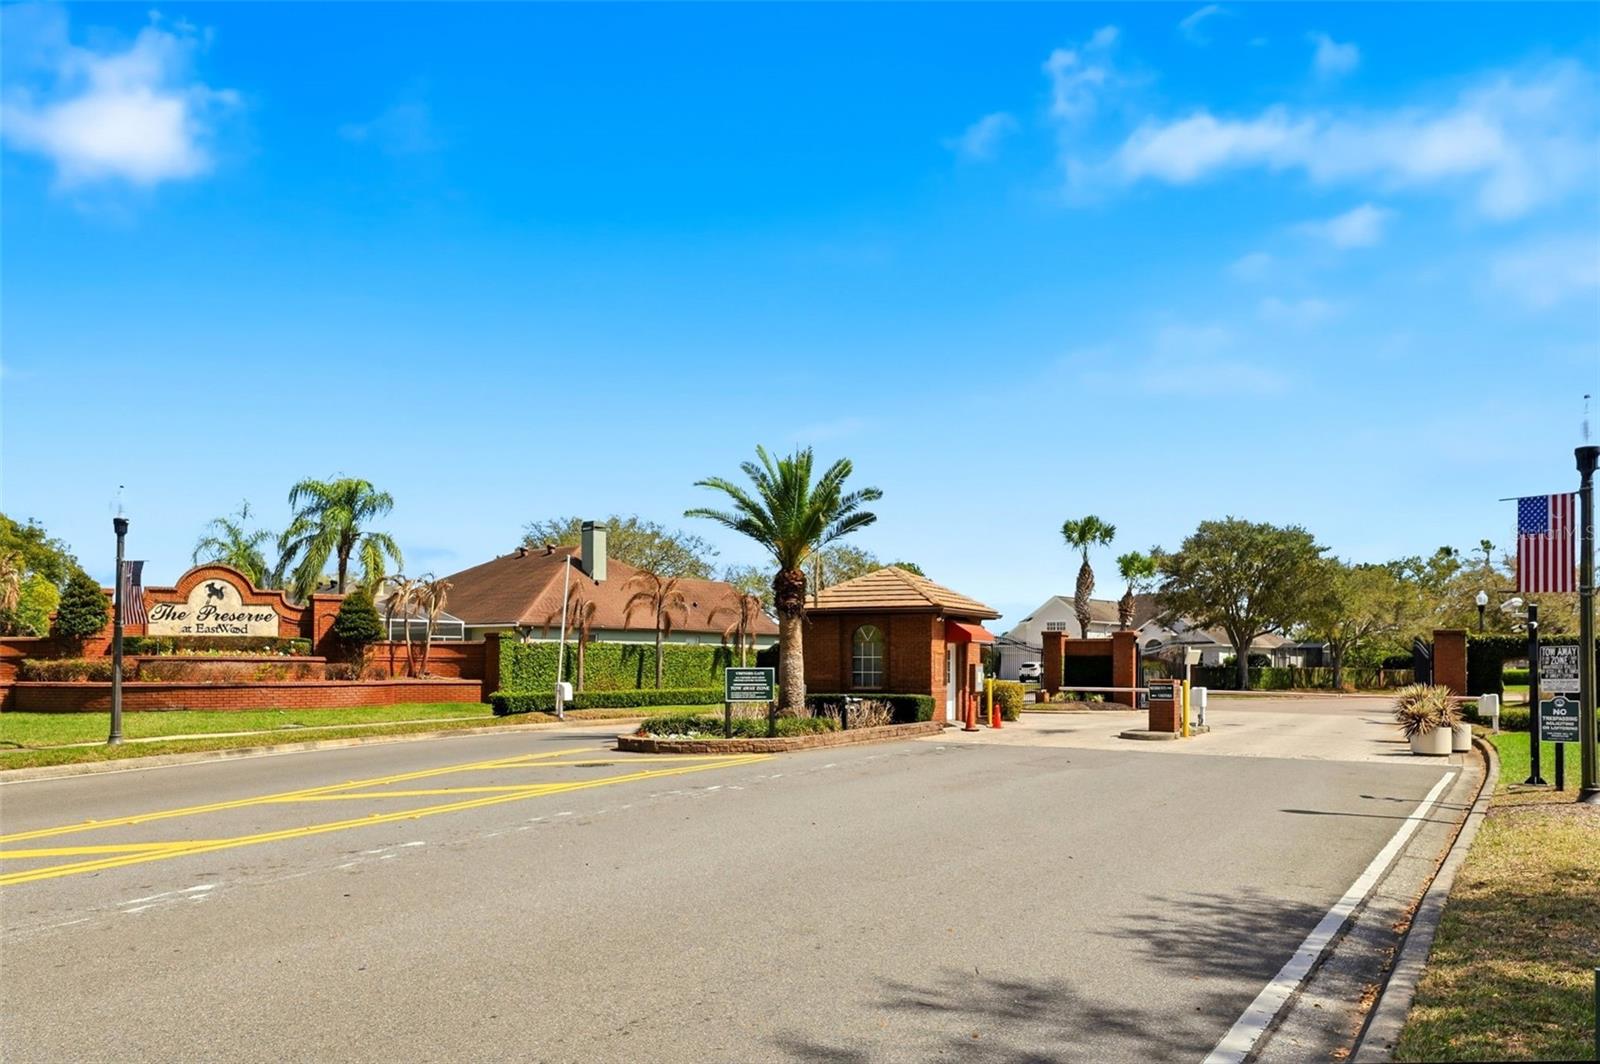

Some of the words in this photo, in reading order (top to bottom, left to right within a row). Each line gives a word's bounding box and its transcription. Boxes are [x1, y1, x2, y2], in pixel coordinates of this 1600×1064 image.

[150, 603, 190, 621] The
[196, 605, 276, 622] Preserve
[181, 624, 192, 634] at
[1557, 647, 1577, 656] AWAY
